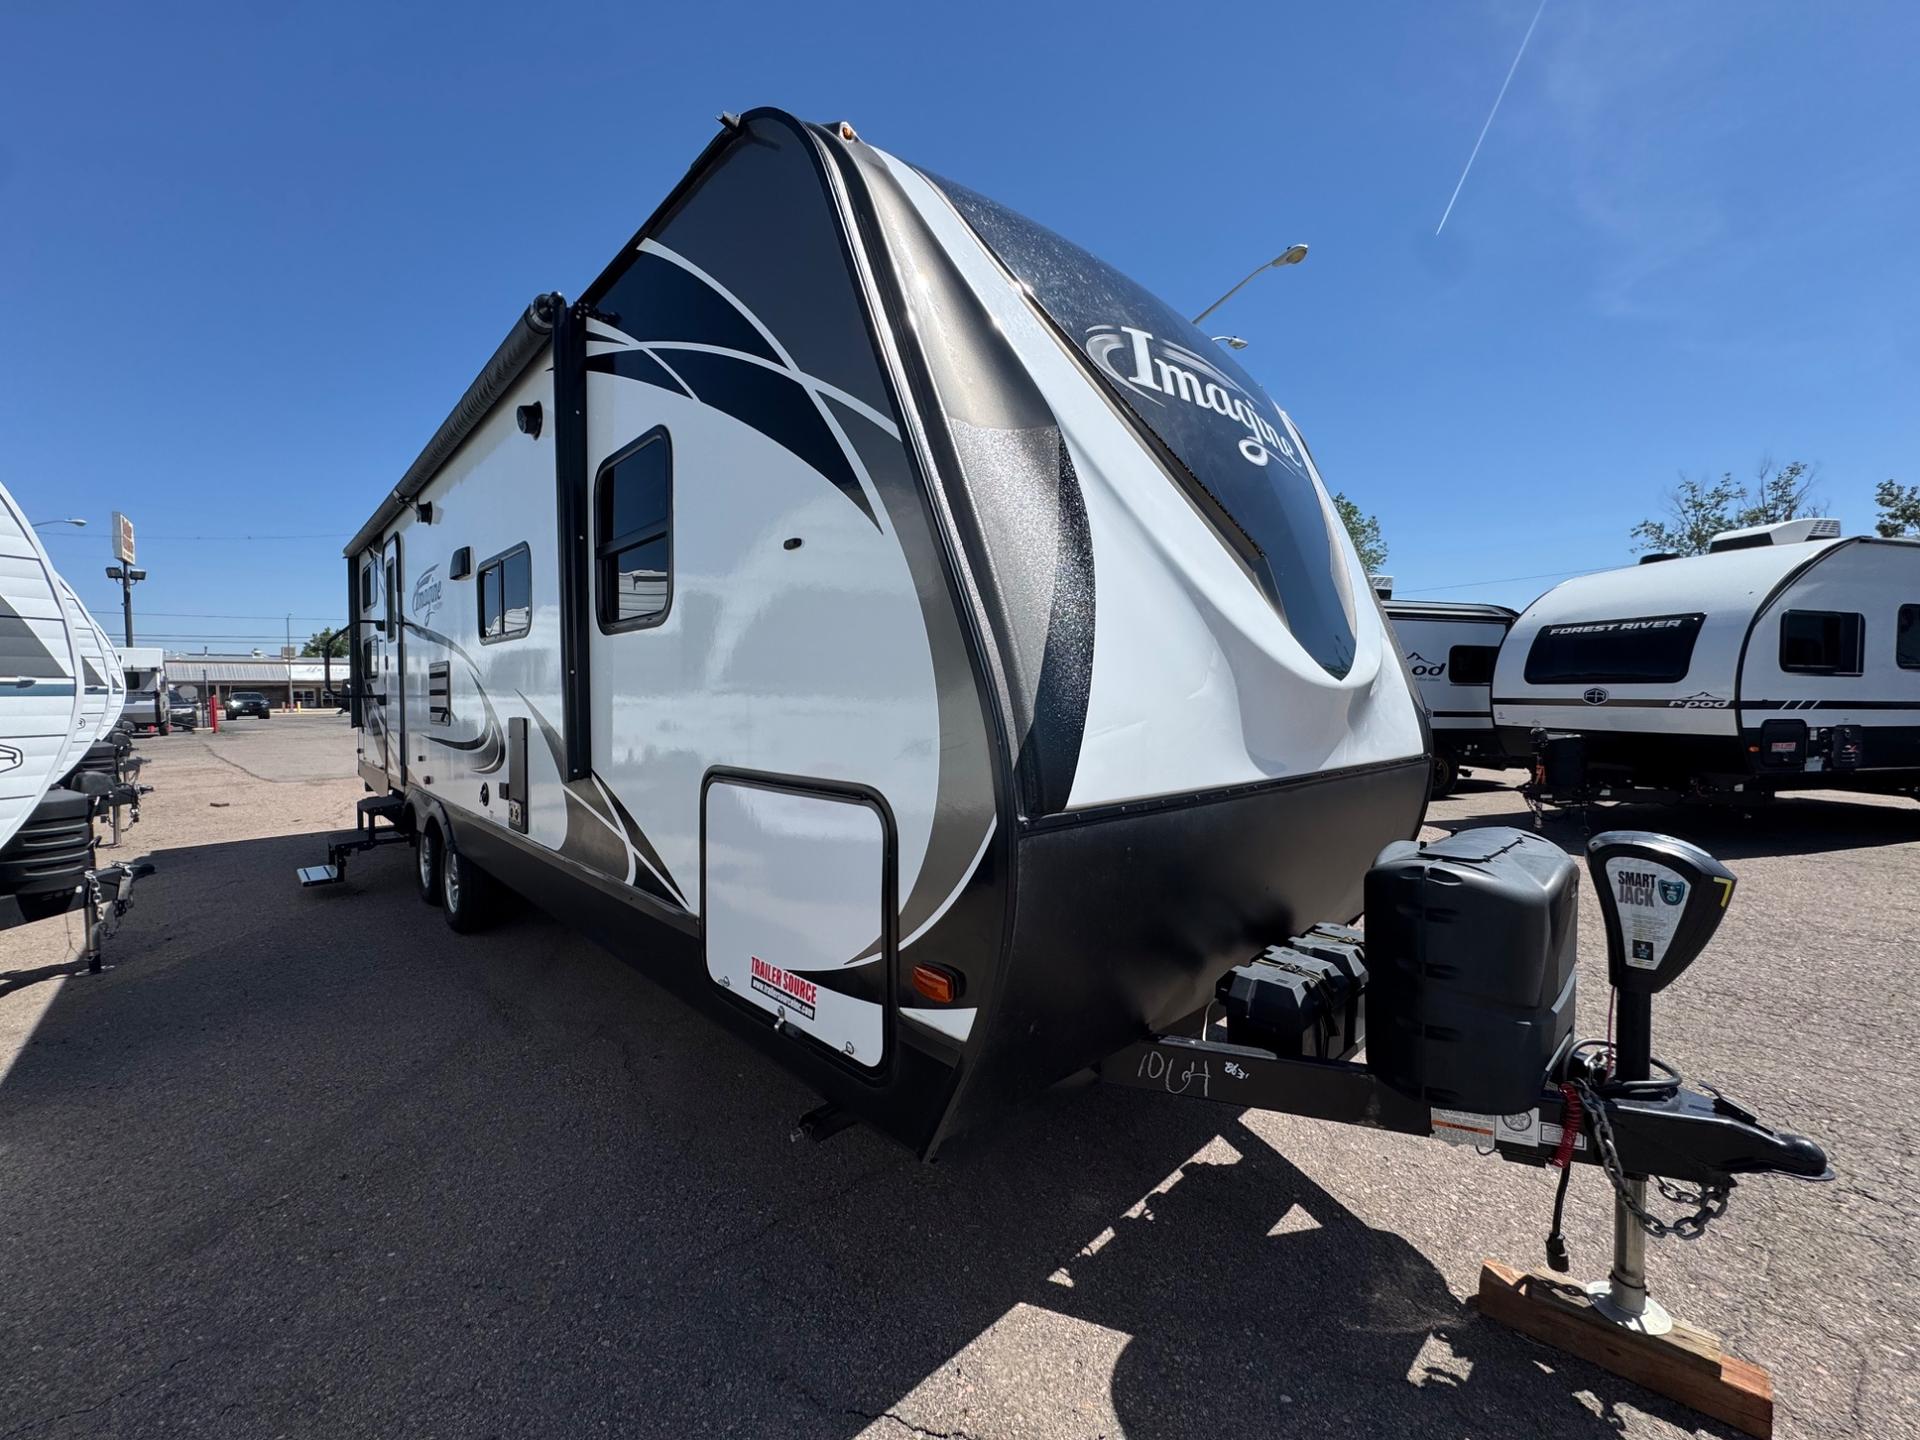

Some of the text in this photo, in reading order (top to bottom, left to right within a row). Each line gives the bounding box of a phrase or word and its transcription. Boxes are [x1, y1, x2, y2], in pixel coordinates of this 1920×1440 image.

[1121, 326, 1301, 467] Imagine
[1549, 619, 1682, 636] FOREST RIVER
[1618, 870, 1657, 889] SMART
[1618, 885, 1655, 908] JACK
[751, 956, 817, 1005] TRAILER SOURCE
